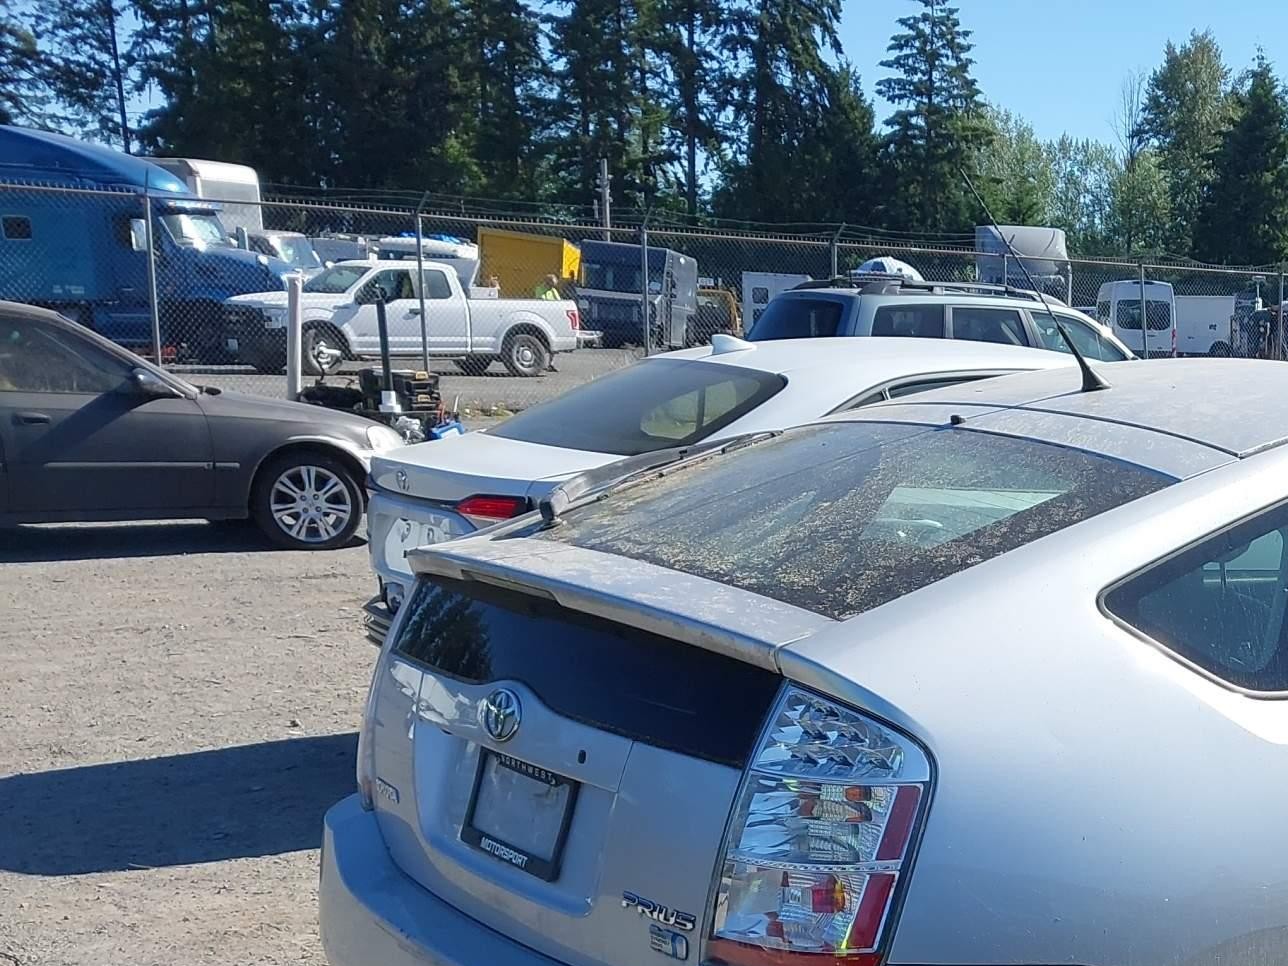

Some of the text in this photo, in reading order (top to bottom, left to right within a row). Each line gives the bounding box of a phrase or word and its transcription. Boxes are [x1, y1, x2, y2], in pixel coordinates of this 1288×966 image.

[500, 754, 553, 780] NORTHWEST
[480, 836, 528, 868] MOTORSPORT
[622, 890, 697, 931] PRIUS
